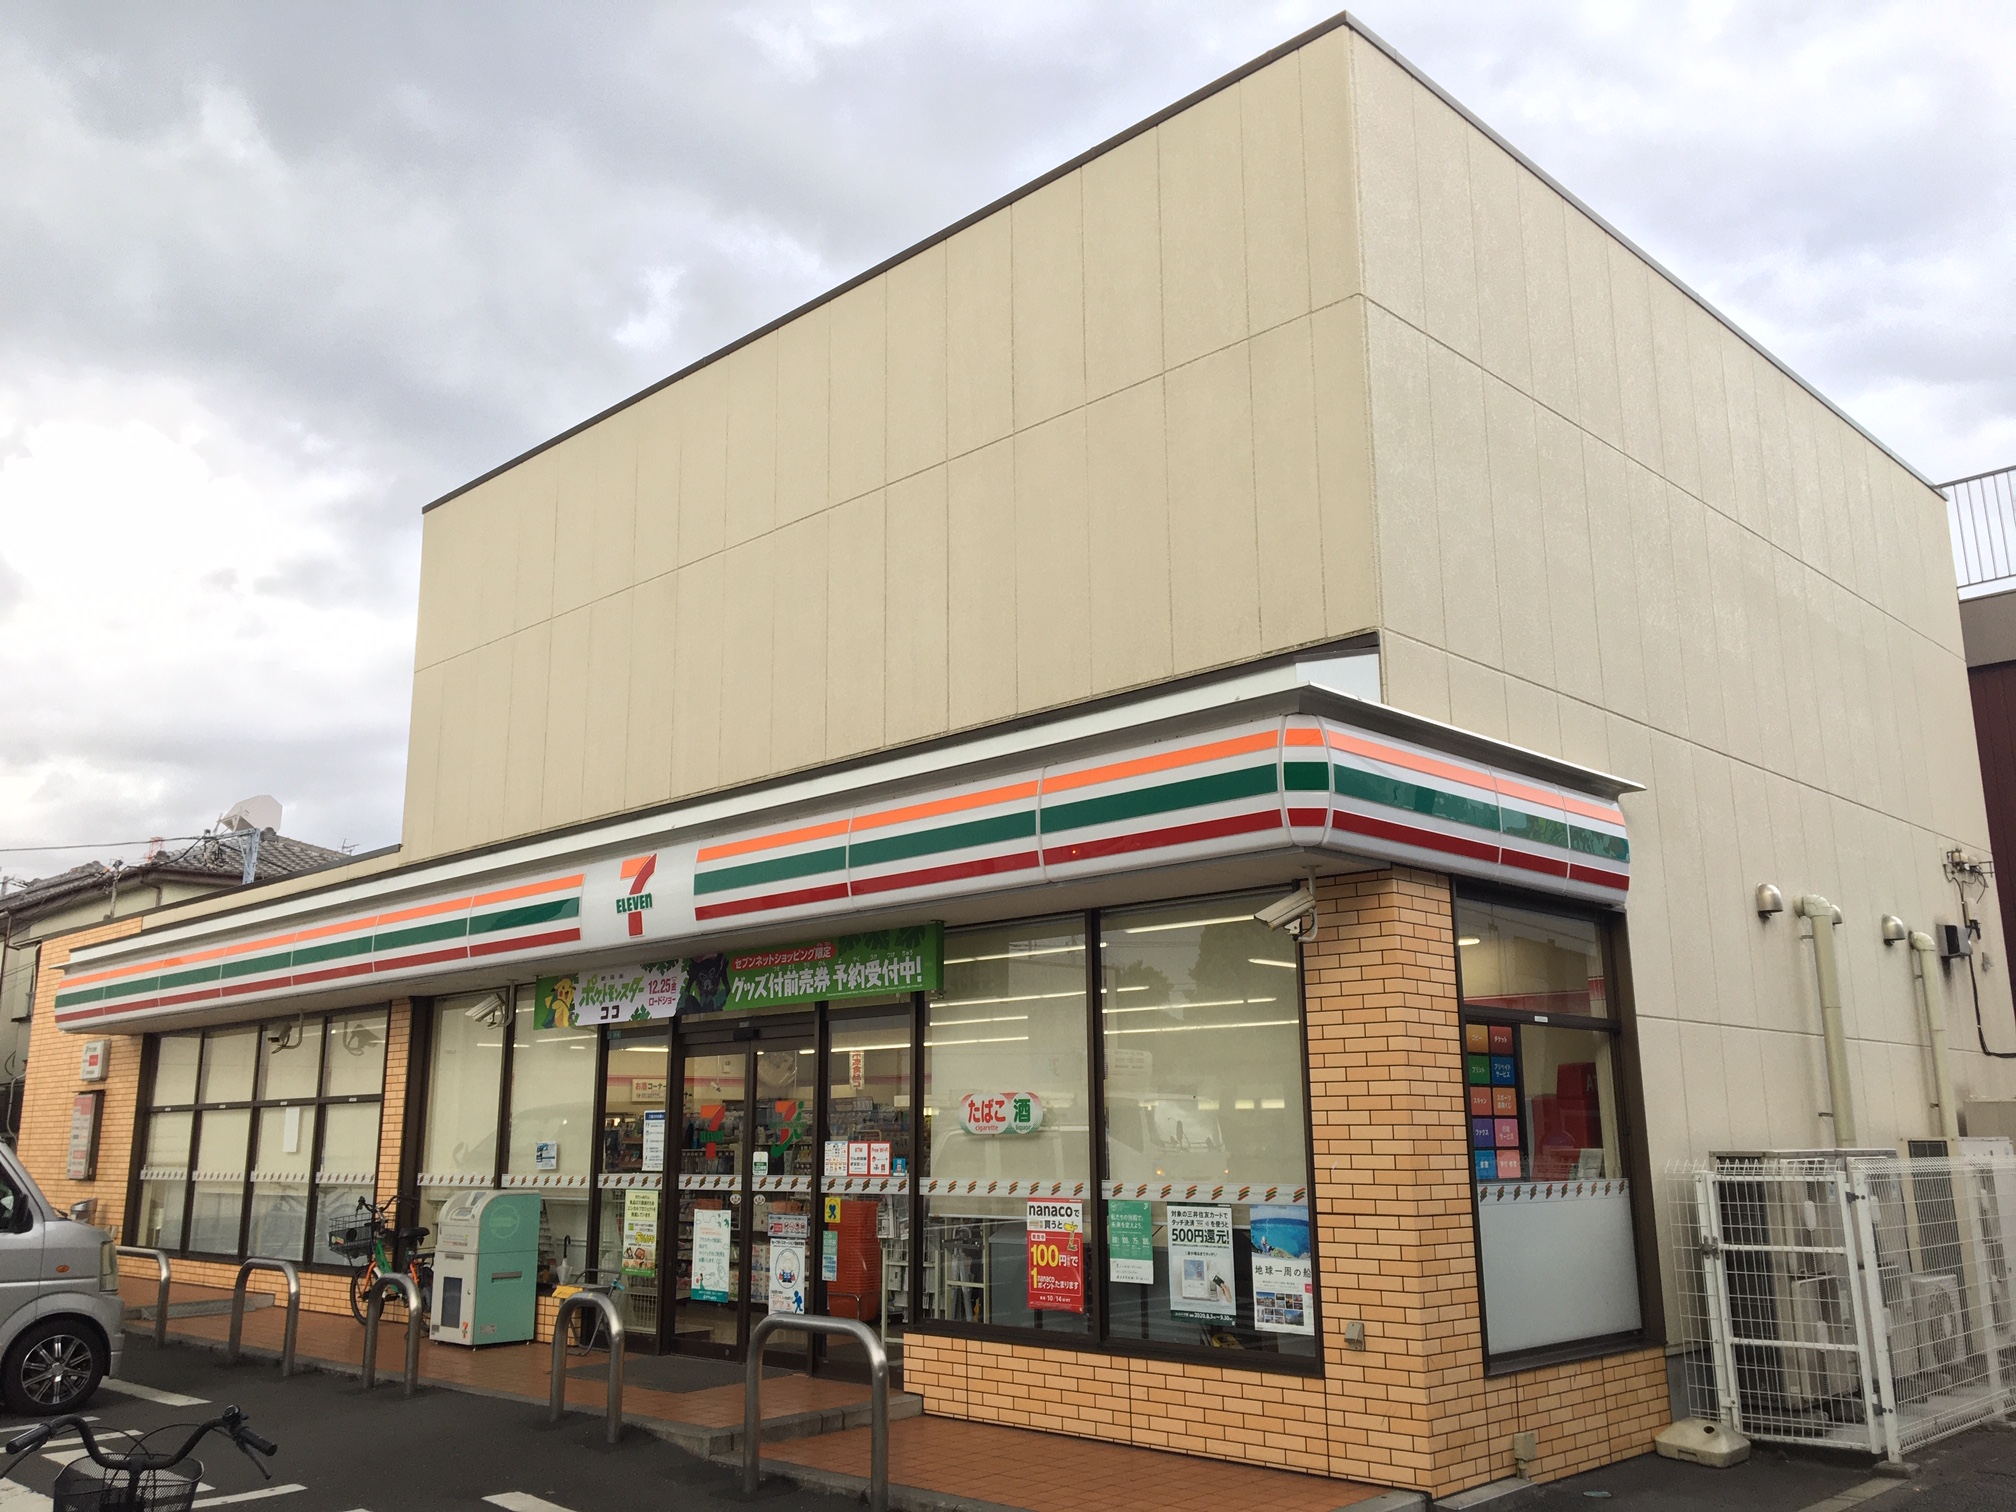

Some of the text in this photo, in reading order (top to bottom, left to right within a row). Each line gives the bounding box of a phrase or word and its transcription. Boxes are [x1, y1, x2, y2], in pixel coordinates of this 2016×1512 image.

[620, 853, 657, 936] 7
[735, 946, 832, 970] セブンネットショッピング限定
[731, 955, 923, 1003] グッズ付前売券 予約受付中!
[579, 974, 645, 1007] ポケットモンスター
[648, 979, 671, 995] 12.25
[648, 996, 676, 1006] ロードショー
[600, 1005, 620, 1020] ココ
[968, 1098, 1007, 1124] たばこ
[1013, 1098, 1032, 1123] 酒
[975, 1124, 999, 1132] cigarette
[1015, 1124, 1031, 1132] liquor
[1029, 1205, 1080, 1218] nanacoで
[1171, 1210, 1228, 1219] 対象の三井住友カードで
[1044, 1220, 1063, 1230] 買うと
[1172, 1219, 1195, 1227] タッチ決済
[1171, 1228, 1230, 1245] 500円還元!
